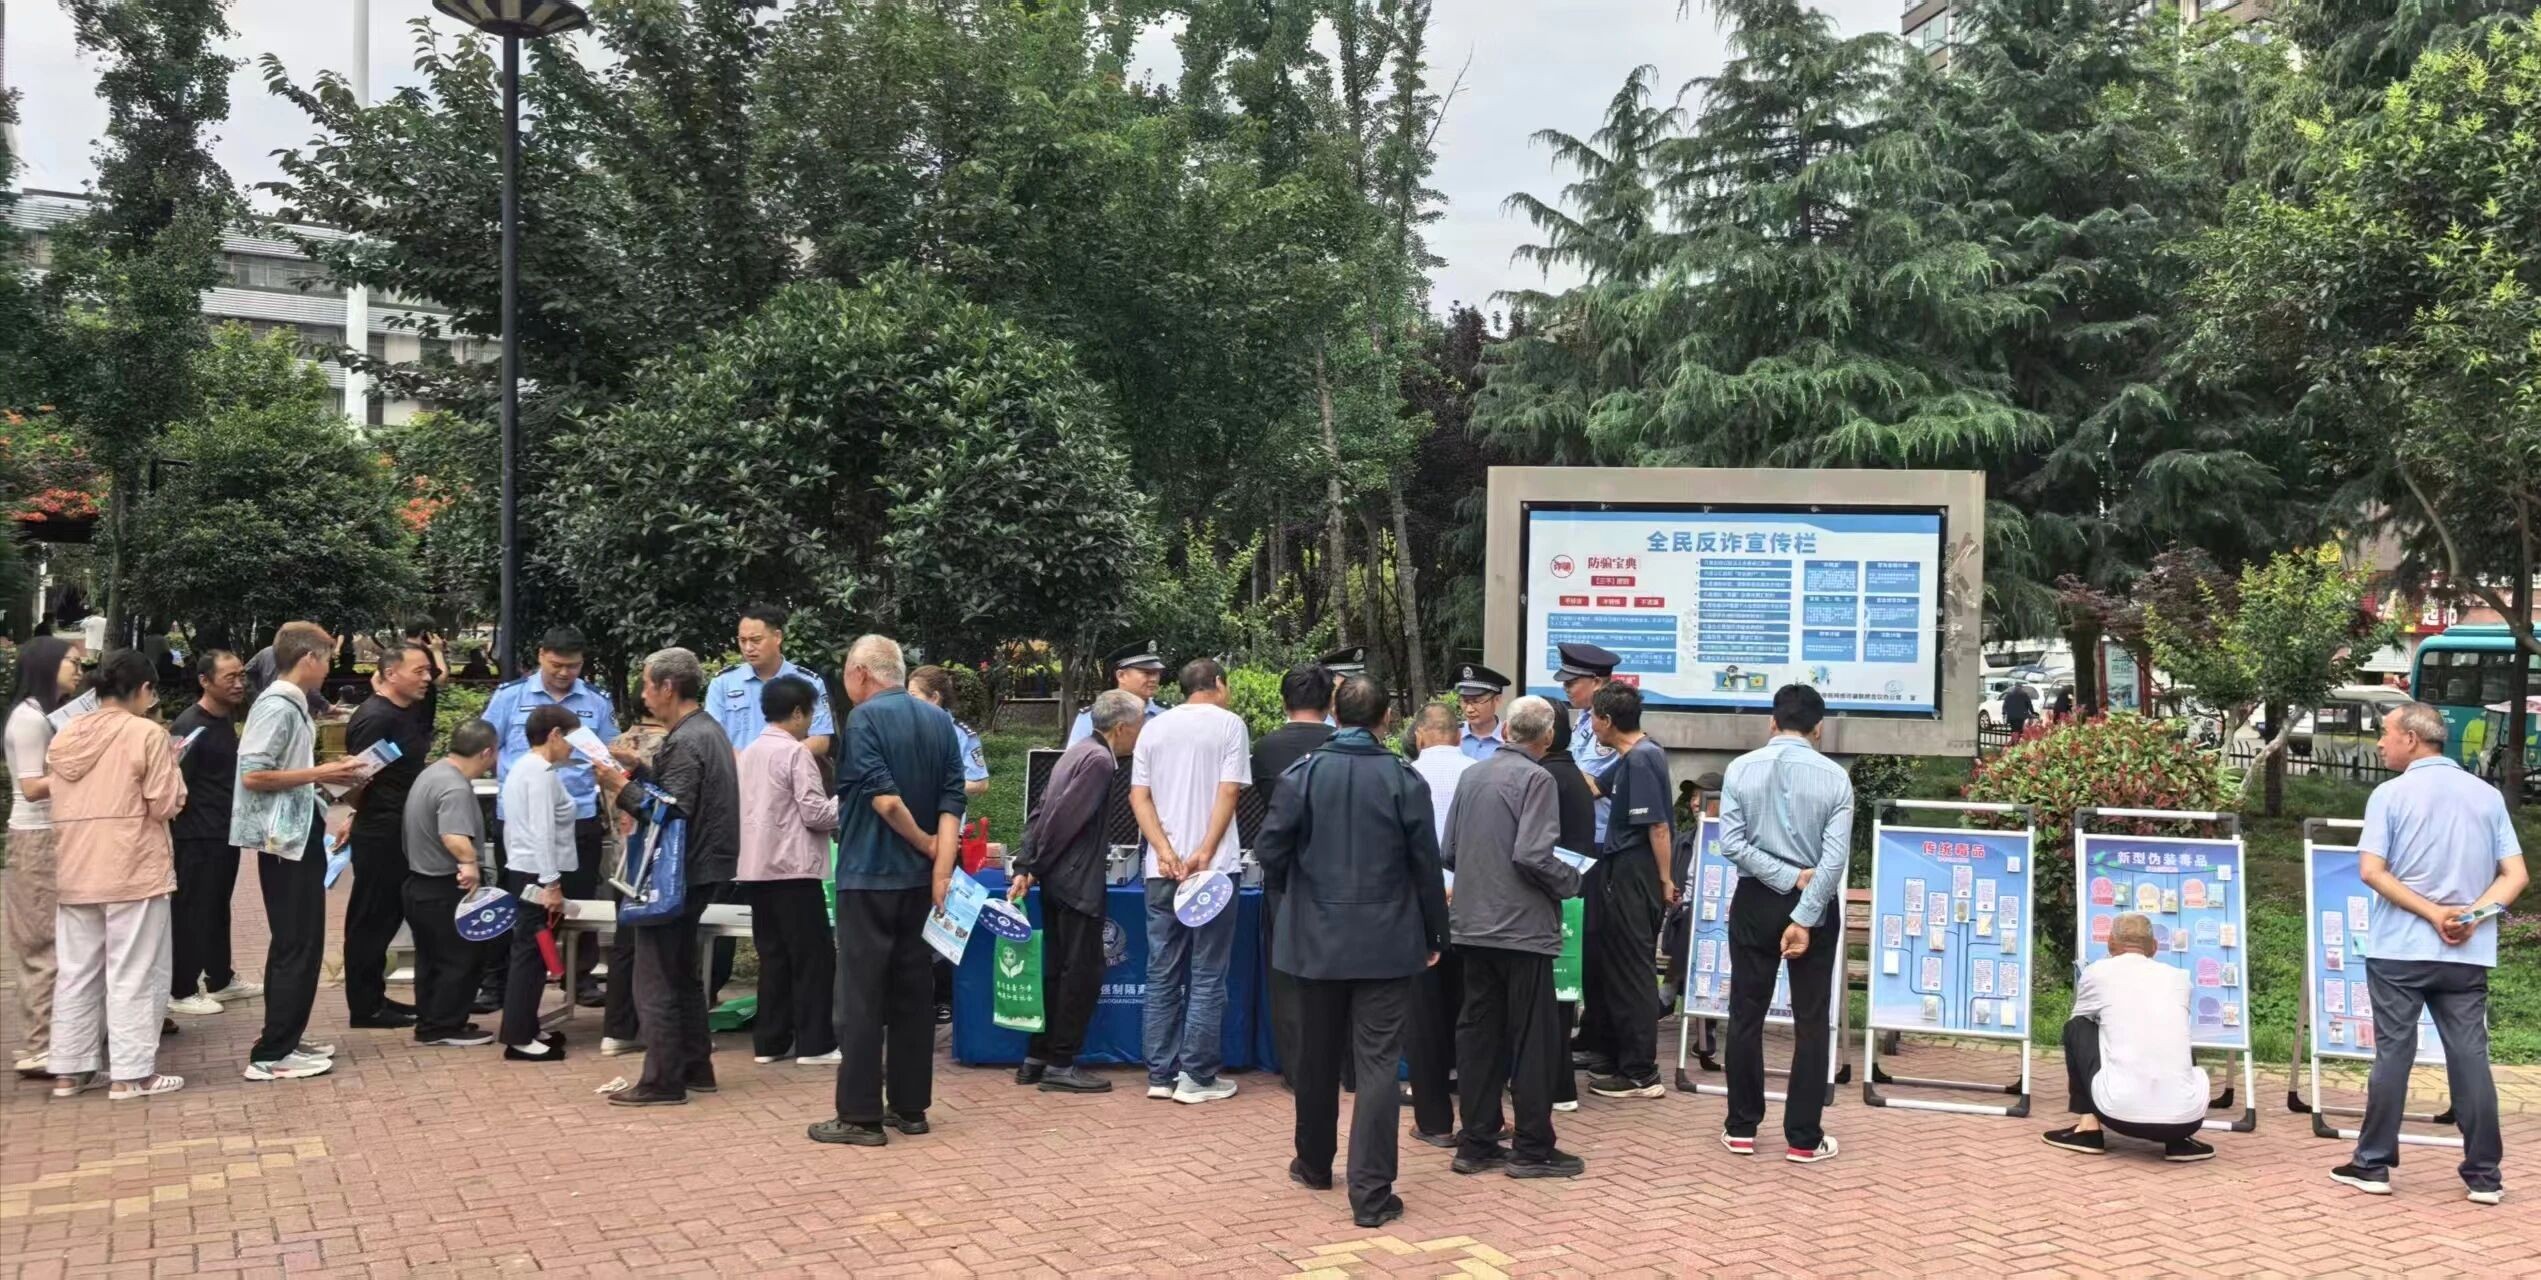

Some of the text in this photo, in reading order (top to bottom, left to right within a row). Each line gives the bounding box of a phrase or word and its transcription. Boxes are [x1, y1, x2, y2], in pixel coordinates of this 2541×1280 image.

[1647, 530, 1817, 554] 全民反诈宣传栏
[1587, 556, 1638, 570] 防骗宝典
[1922, 841, 1985, 858] 传统毒品
[2117, 851, 2208, 867] 新型伪装毒品
